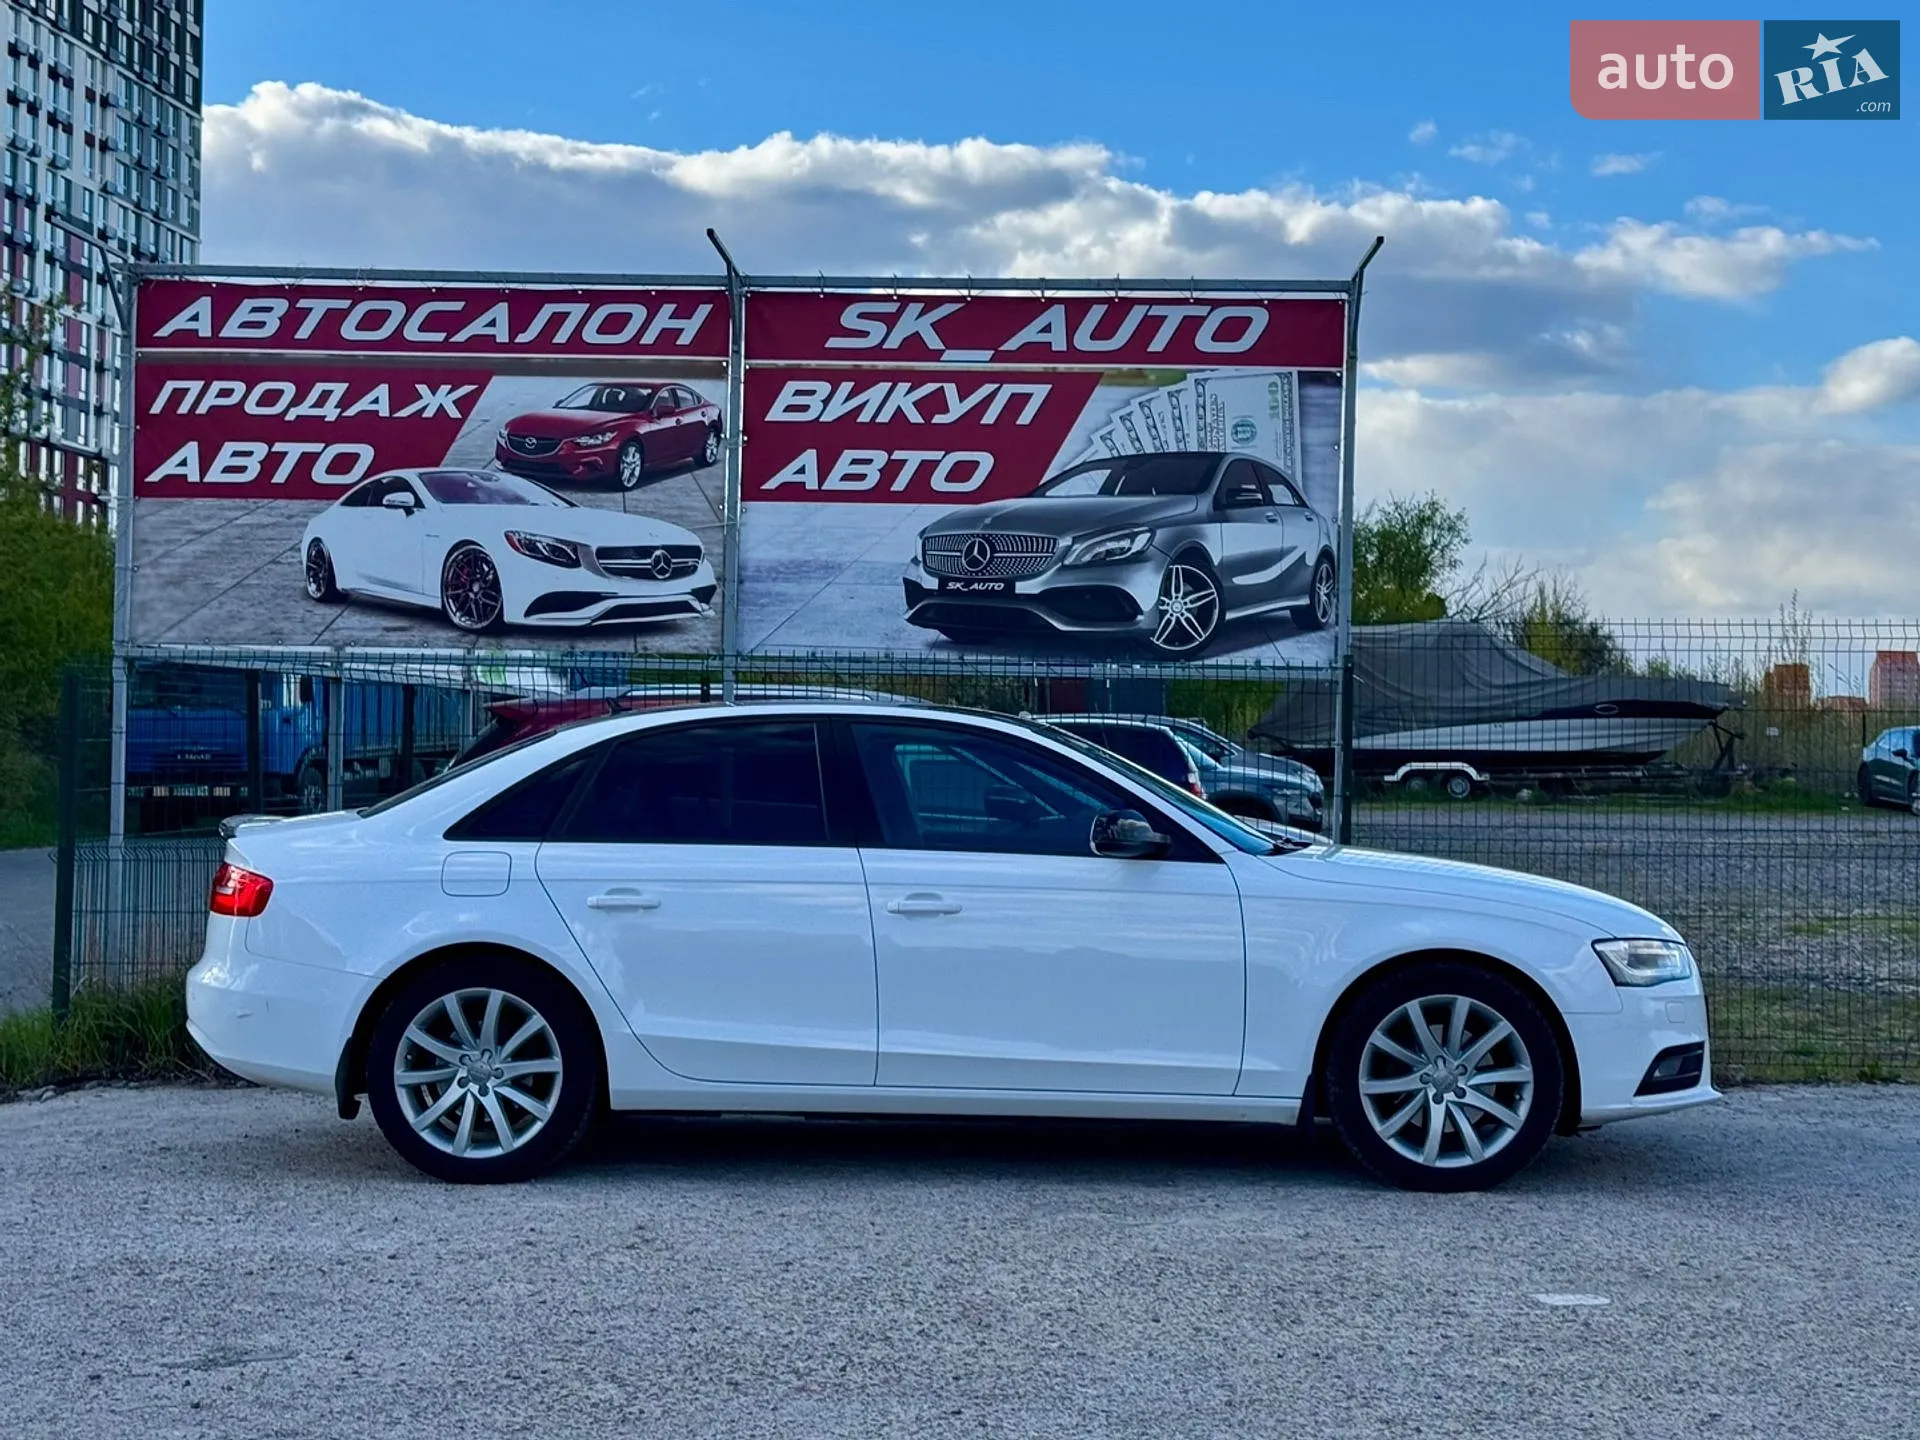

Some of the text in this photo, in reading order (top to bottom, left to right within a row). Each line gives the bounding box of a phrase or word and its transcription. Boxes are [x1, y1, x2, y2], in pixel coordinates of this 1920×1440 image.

[153, 296, 713, 345] АВТОСАЛОН
[824, 302, 1270, 362] SK_AUTO
[149, 380, 479, 422] ПРОДАЖ
[764, 380, 1053, 425] ВИКУП
[144, 441, 375, 484] АВТО
[760, 449, 995, 492] АВТО
[946, 581, 1005, 592] SK_AUTO
